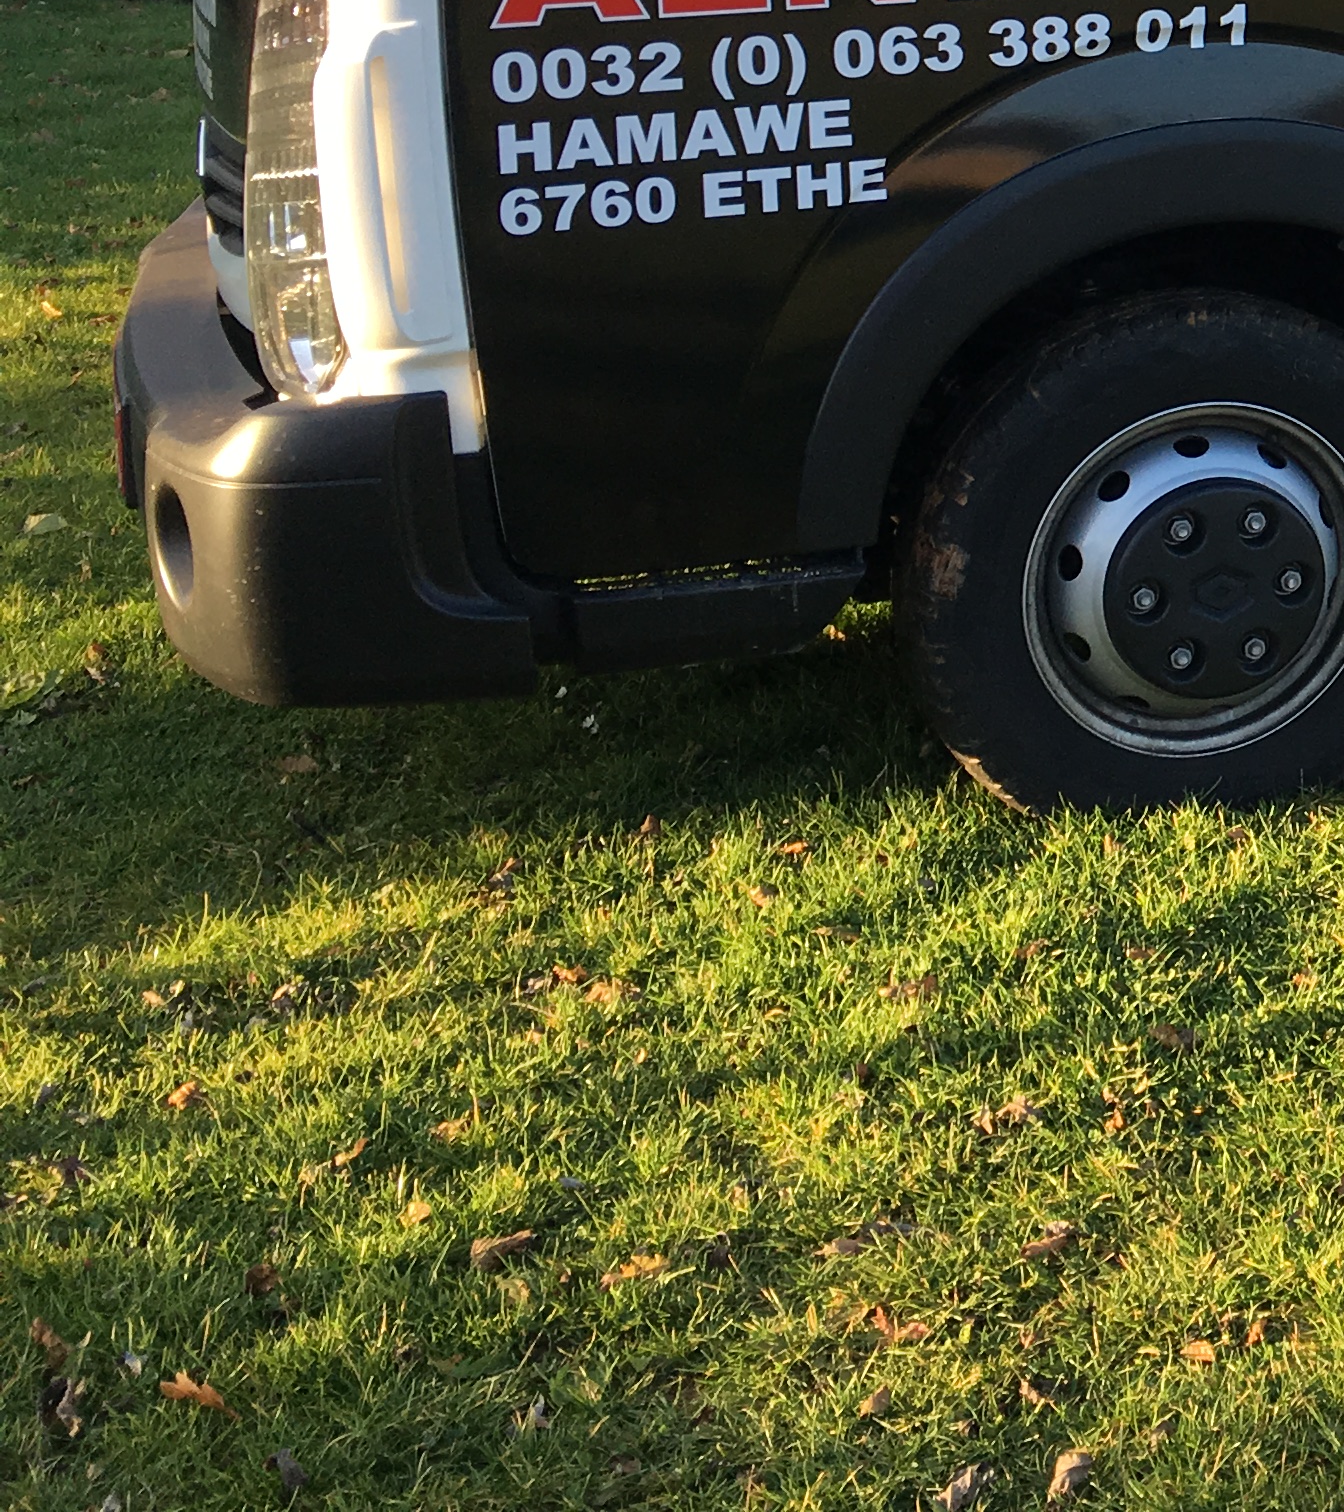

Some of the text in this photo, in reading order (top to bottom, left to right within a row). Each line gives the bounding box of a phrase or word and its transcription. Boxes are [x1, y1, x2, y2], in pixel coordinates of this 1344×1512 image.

[492, 3, 1248, 104] 0032 (0) 063 388 011
[497, 99, 853, 175] HAMAWE
[500, 158, 888, 237] 6760 ETHE
